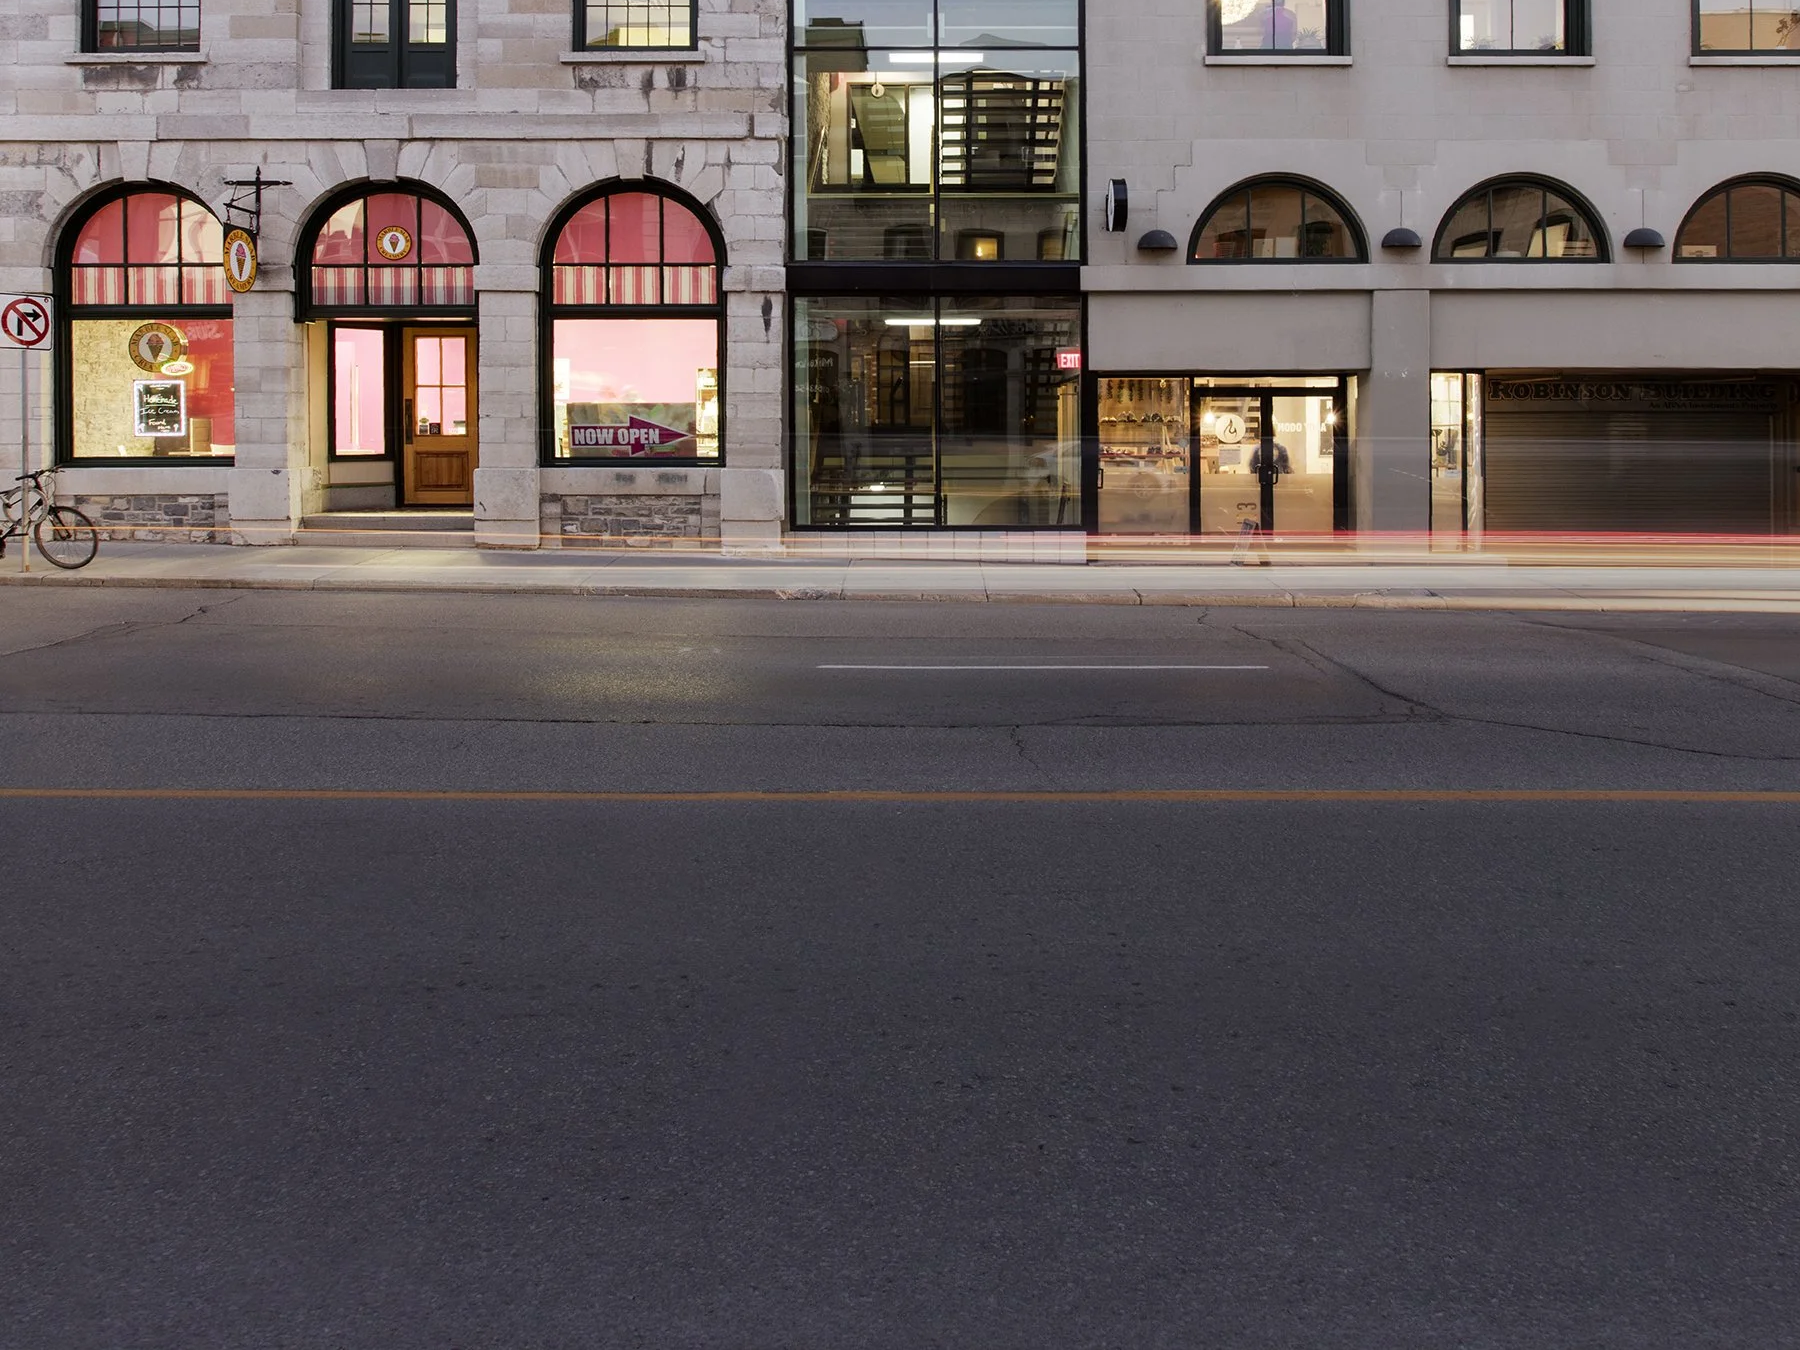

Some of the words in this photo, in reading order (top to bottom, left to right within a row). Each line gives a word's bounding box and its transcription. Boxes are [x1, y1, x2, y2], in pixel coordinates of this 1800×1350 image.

[131, 324, 161, 346] MARBLE
[1060, 353, 1080, 368] EXIT
[1488, 379, 1633, 402] ROBINSON
[1640, 382, 1777, 402] BUILDING
[1277, 423, 1302, 432] MODO
[574, 428, 614, 445] NOW
[617, 428, 660, 445] OPEN
